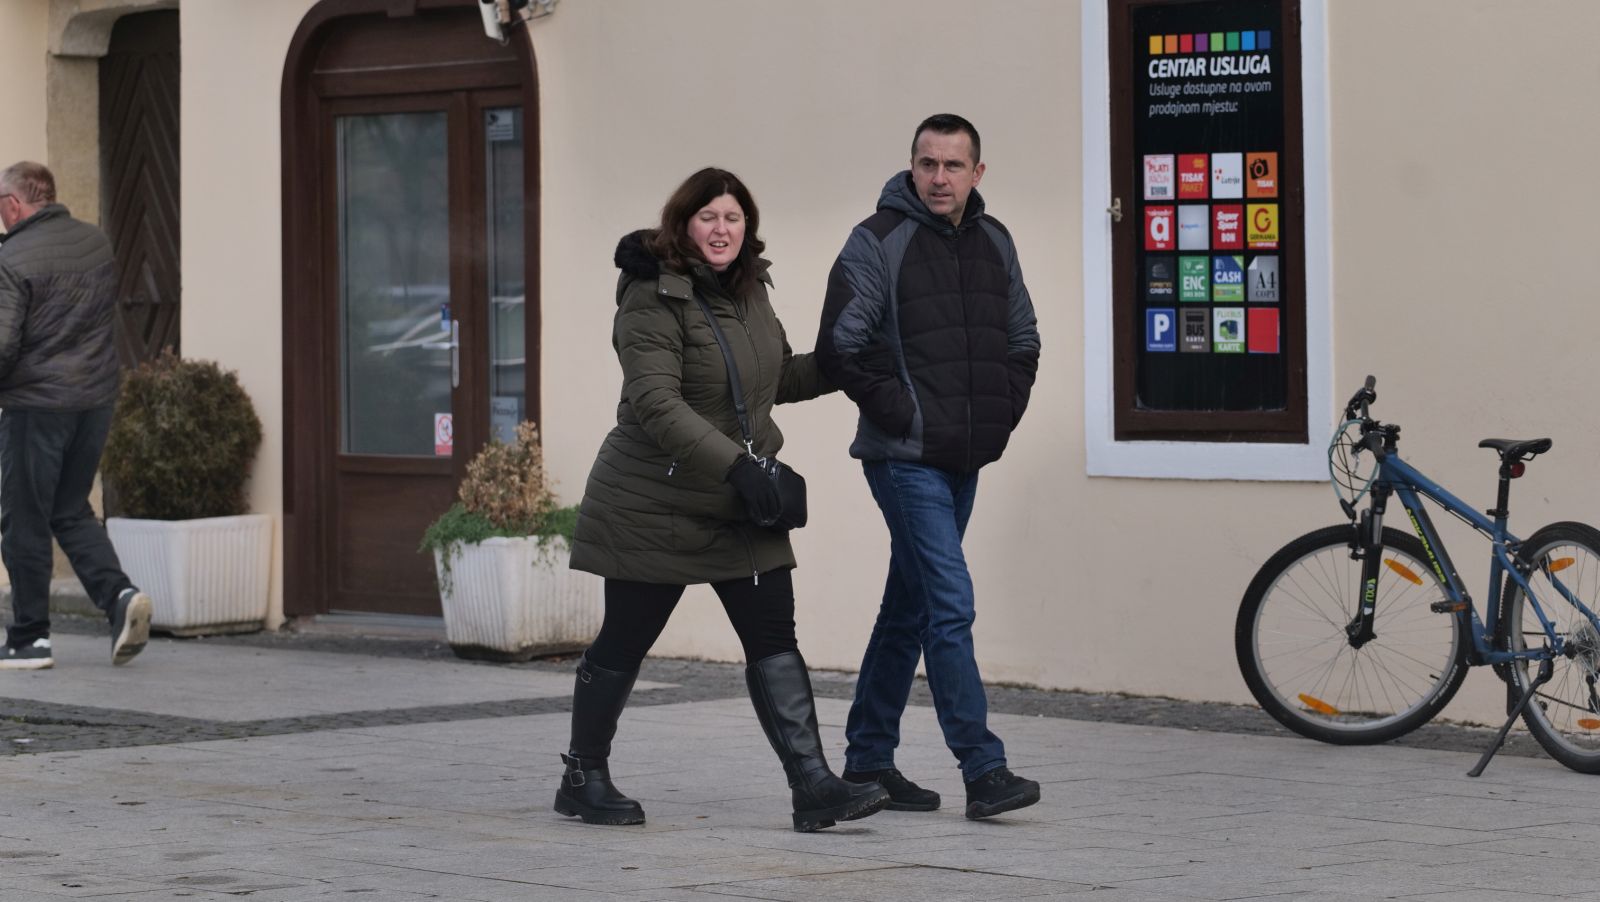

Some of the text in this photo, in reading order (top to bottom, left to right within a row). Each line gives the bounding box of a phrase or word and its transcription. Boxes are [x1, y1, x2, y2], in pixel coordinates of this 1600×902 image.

[1149, 54, 1271, 78] CENTAR USLUGA
[1149, 81, 1272, 99] Usluge dostupne na ovom
[1149, 100, 1239, 118] prodajnom mjestu:
[1181, 172, 1204, 183] TISAK
[1183, 275, 1206, 291] ENC
[1215, 271, 1241, 283] CASH
[1256, 271, 1277, 289] A4
[1154, 313, 1170, 341] P
[1186, 324, 1205, 337] BUS
[1218, 343, 1241, 351] KARTE
